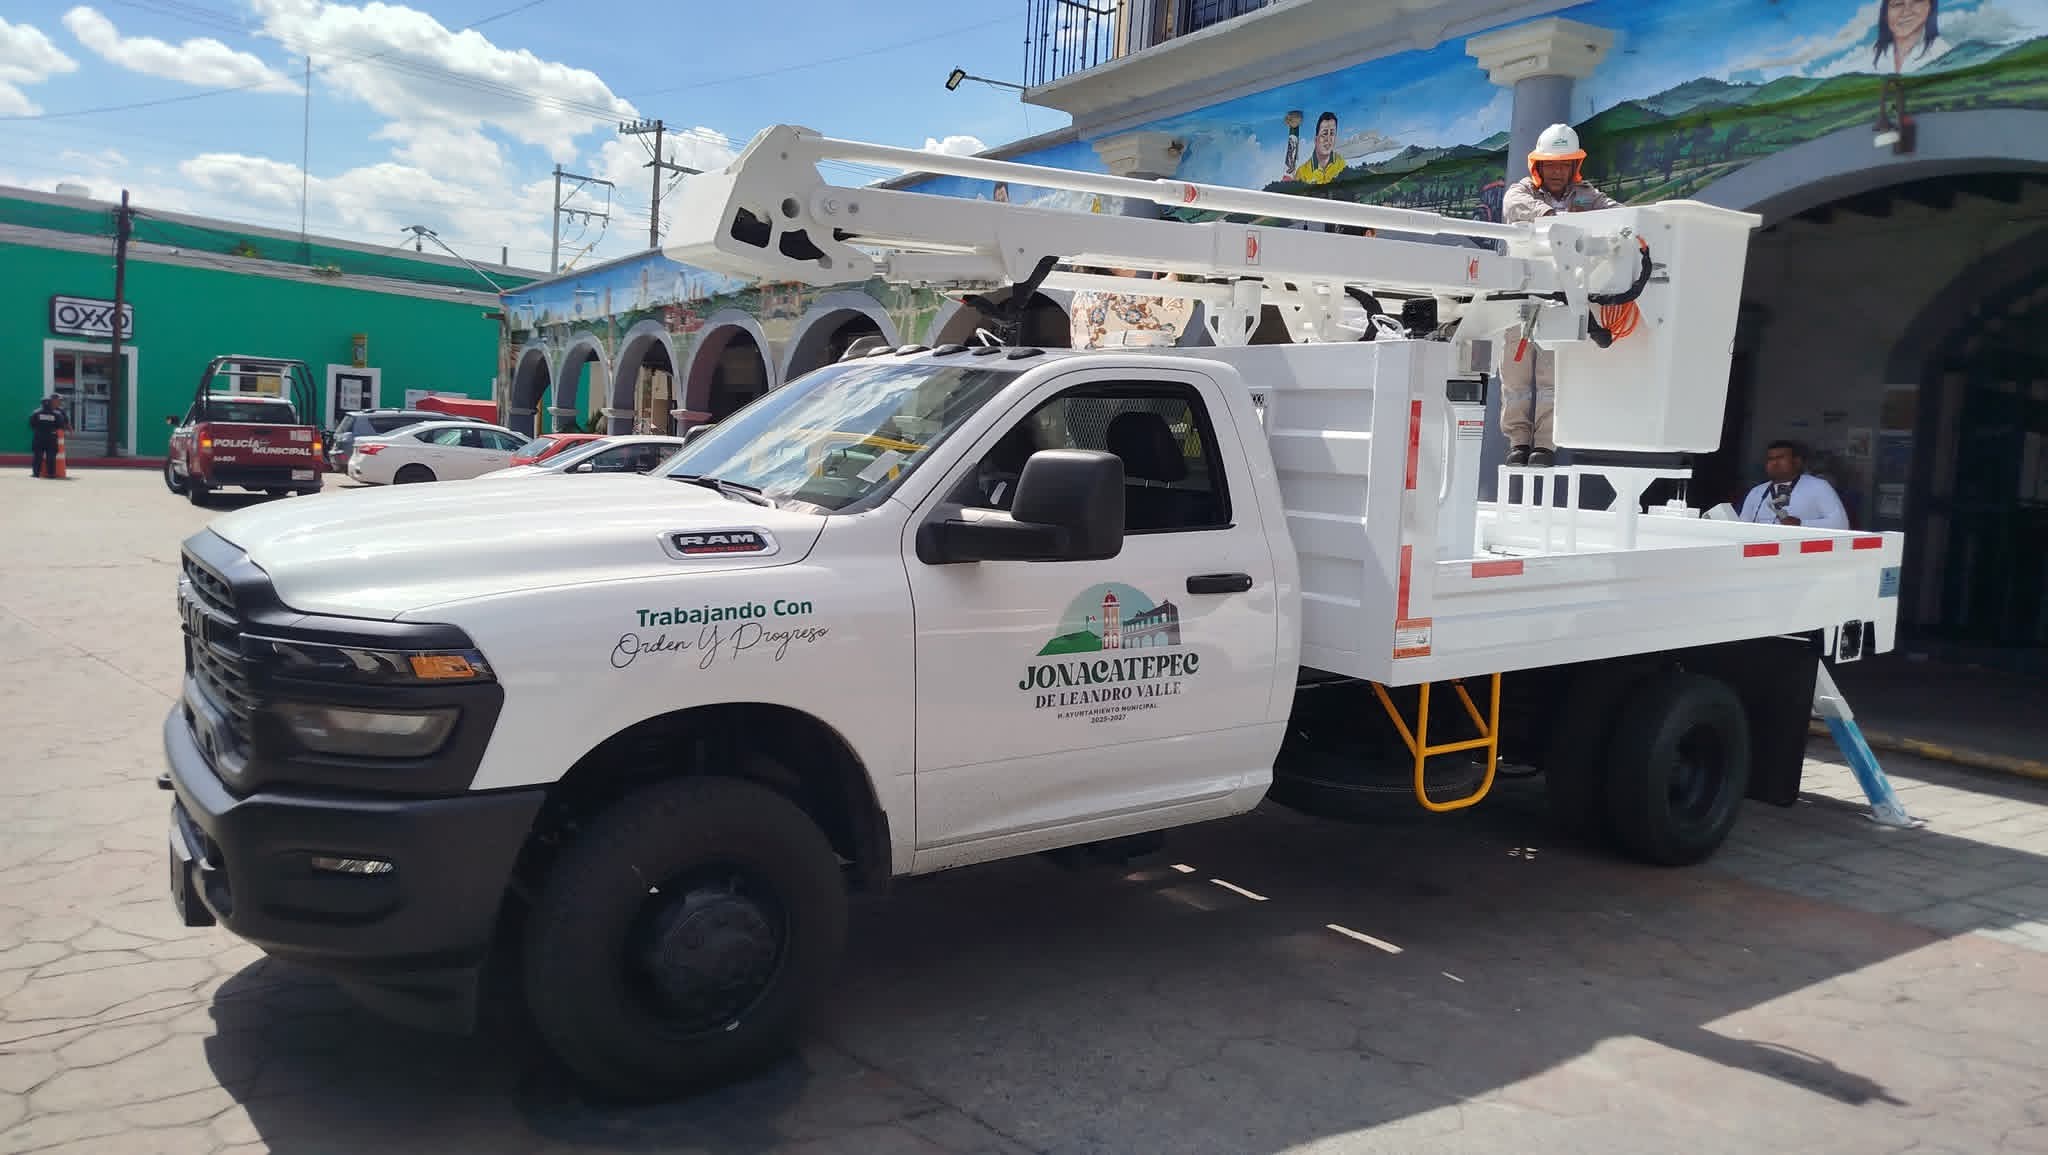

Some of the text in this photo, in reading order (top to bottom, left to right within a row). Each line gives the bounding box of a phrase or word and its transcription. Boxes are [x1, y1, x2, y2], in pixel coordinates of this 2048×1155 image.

[58, 306, 129, 330] OXXO
[214, 438, 259, 449] POLICÍA
[252, 447, 312, 456] MUNICIPAL
[680, 534, 754, 546] RAM
[636, 599, 813, 627] Trabajando Con
[611, 622, 830, 669] Orden Y Progreso
[1018, 652, 1199, 691] JONACATEPEC
[1035, 682, 1181, 709] DE LEANDRO VALLE
[1122, 703, 1157, 713] MUNICIPAL
[1090, 714, 1126, 723] 2025-2027
